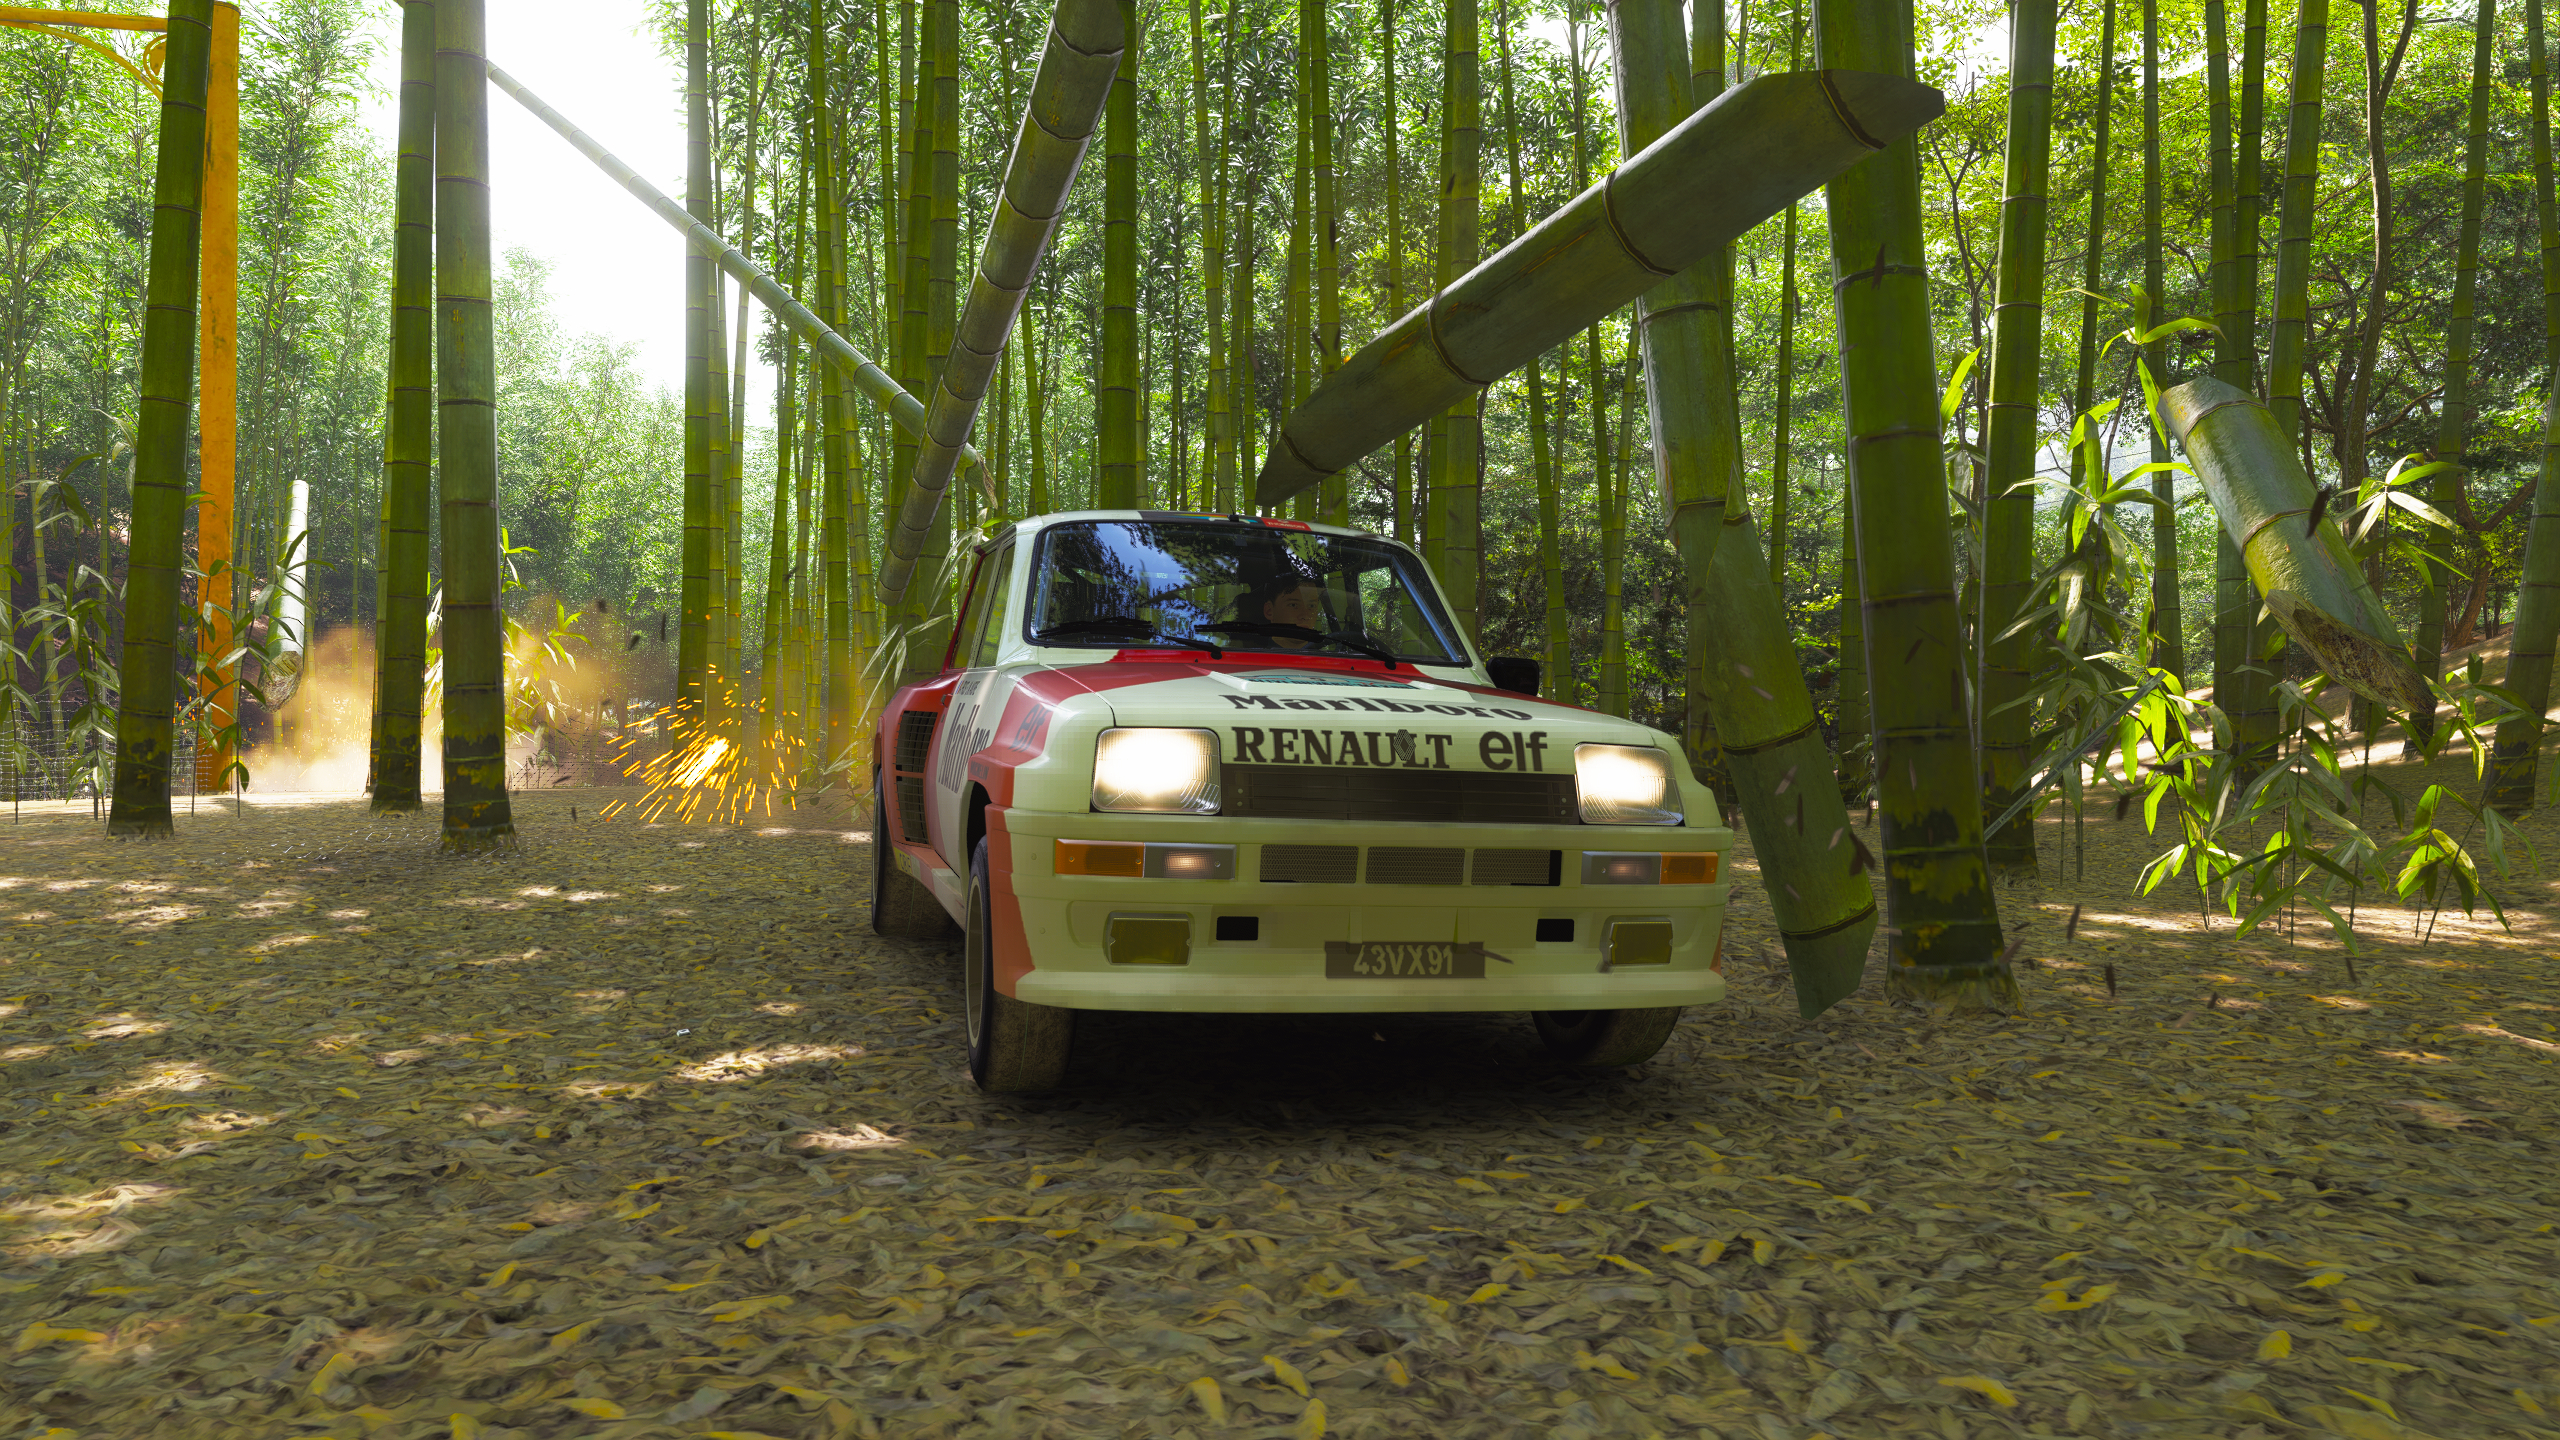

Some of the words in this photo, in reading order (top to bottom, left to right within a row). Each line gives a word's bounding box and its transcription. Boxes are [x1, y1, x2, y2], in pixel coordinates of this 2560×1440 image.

[1219, 694, 1533, 721] Marlboro
[1008, 703, 1053, 753] elf
[1231, 726, 1453, 769] RENAULT
[1479, 731, 1548, 772] elf
[1353, 944, 1453, 975] 43VX91
